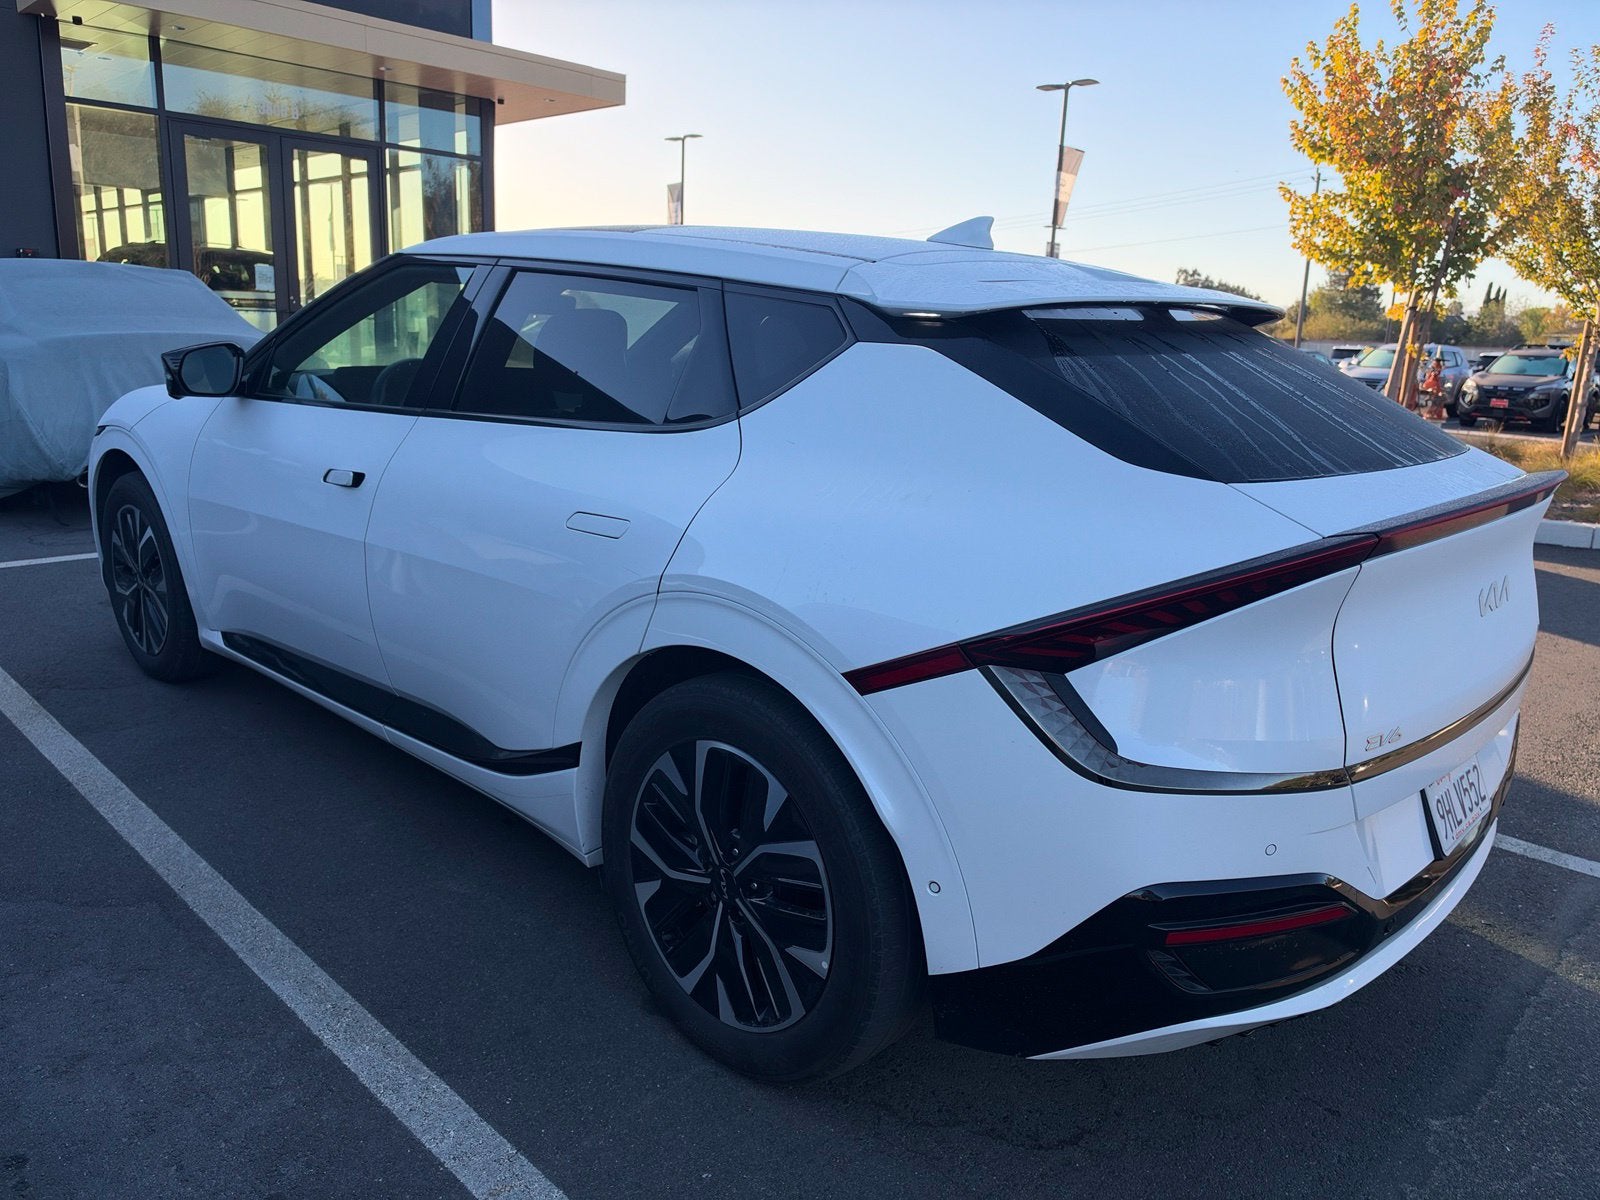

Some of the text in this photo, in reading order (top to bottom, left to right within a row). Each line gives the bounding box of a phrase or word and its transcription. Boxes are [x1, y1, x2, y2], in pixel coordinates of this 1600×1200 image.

[1478, 575, 1509, 617] KIA
[1365, 726, 1402, 751] EV6
[1435, 764, 1487, 841] 9HLV552
